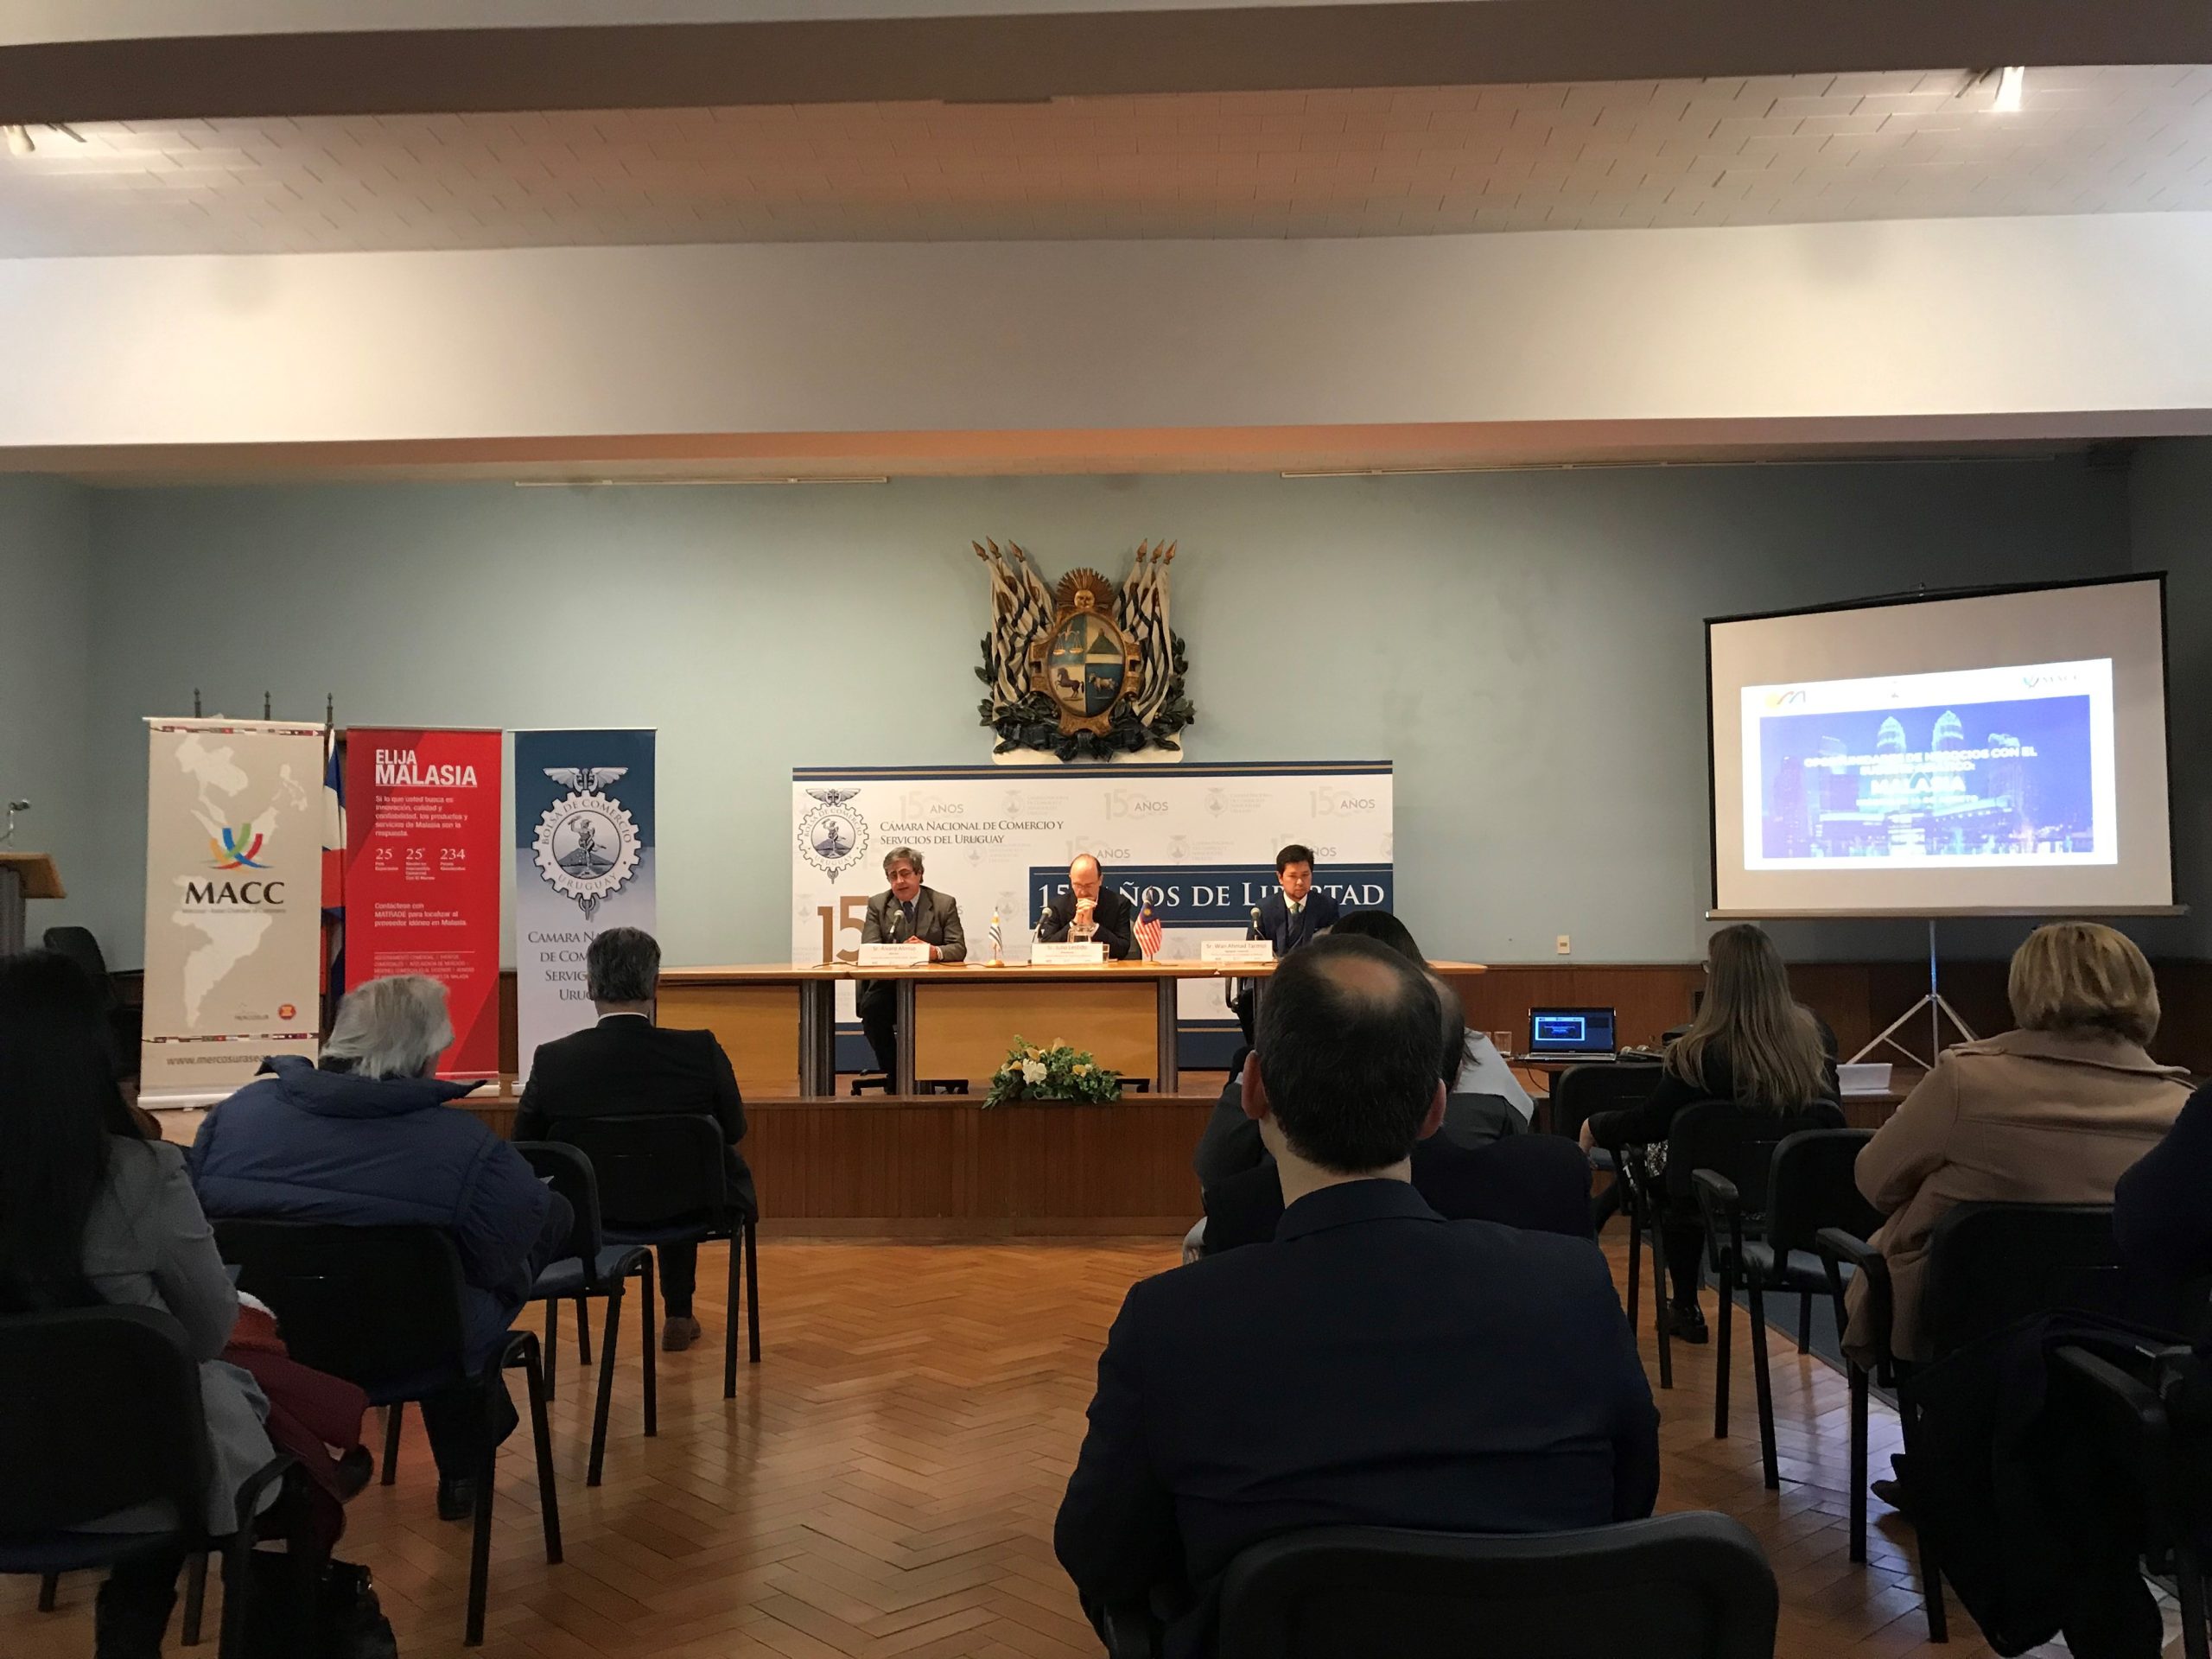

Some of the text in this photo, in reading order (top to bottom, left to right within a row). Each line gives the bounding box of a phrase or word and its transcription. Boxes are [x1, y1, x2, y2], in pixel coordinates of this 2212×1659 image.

[376, 749, 416, 765] ELIJA
[1991, 747, 2019, 758] CON
[2022, 747, 2037, 757] EL
[376, 765, 477, 785] MALASIA
[1340, 798, 1376, 810] AÑOS
[542, 798, 632, 845] BOLSA DE COMERCIO
[926, 821, 981, 831] NACIONAL
[982, 822, 996, 830] DE
[998, 820, 1055, 830] COMERCIO
[1057, 821, 1064, 830] Y
[880, 834, 1005, 845] SERVICIOS DEL URUGUAY
[441, 849, 465, 860] 234
[815, 855, 852, 865] URUGUAY
[558, 872, 616, 891] URUGUAY
[185, 881, 285, 905] MACC
[1192, 886, 1230, 906] DE
[528, 931, 581, 943] CAMARA
[540, 951, 557, 962] DE
